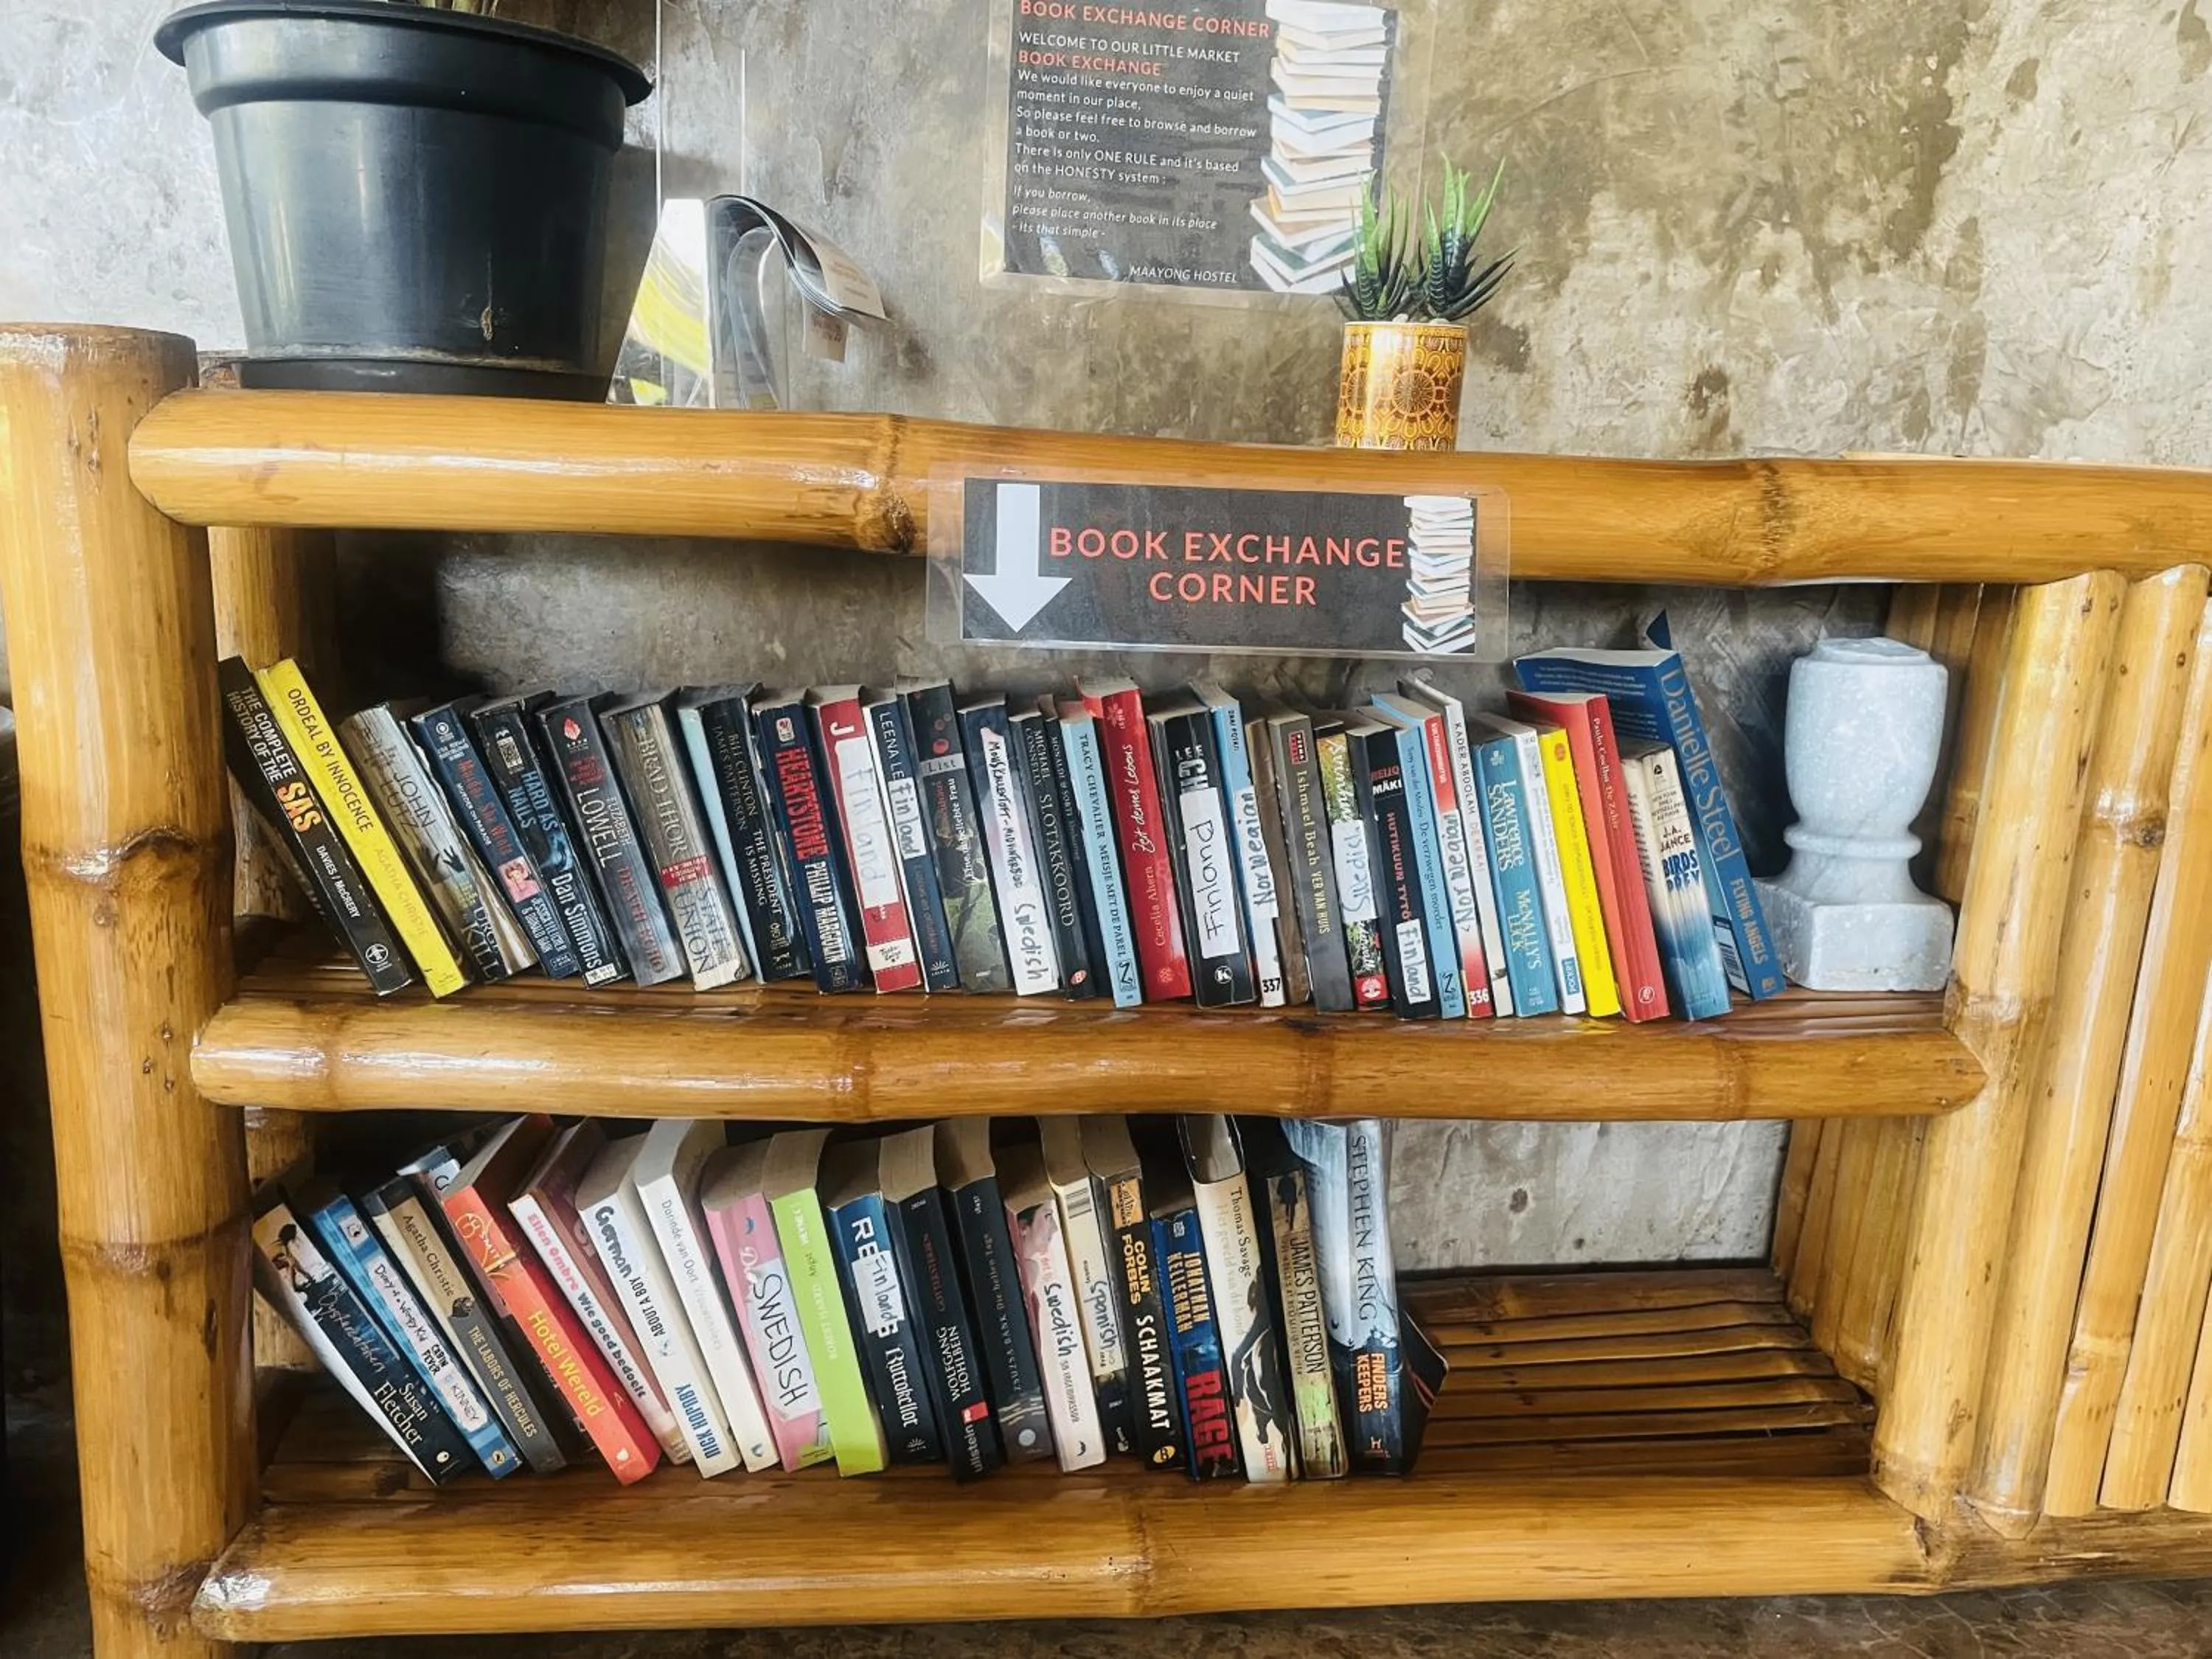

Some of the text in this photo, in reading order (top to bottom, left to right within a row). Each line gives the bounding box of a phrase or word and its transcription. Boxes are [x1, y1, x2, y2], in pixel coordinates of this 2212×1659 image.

[1019, 32, 1239, 63] WELCOME TO OUR LITTLE MARKET
[1021, 0, 1270, 38] BOOK EXCHANGE CORNER
[1018, 51, 1162, 76] BOOK EXCHANGE
[1018, 70, 1253, 103] We would like everyone to enjoy a quiet
[1017, 107, 1256, 138] So please feel free to browse and borrow
[1018, 90, 1141, 111] moment in our place,
[1015, 143, 1048, 157] There
[1053, 147, 1062, 158] is
[1065, 147, 1091, 164] only
[1094, 149, 1121, 162] ONE
[1125, 152, 1156, 166] RULE
[1160, 155, 1180, 168] and
[1206, 159, 1239, 173] based
[1016, 126, 1099, 143] a book or two.
[1013, 186, 1090, 203] If you borrow,
[1015, 164, 1161, 184] on the HONESTY system
[1012, 204, 1217, 230] please place another book in its place
[1037, 223, 1057, 236] that
[1062, 226, 1098, 240] simple
[1130, 265, 1237, 284] MAAYONG HOSTEL
[1050, 527, 1405, 568] BOOK EXCHANGE
[1149, 572, 1316, 605] CORNER
[228, 692, 283, 784] HISTORY THE
[254, 712, 295, 777] COMPLETE
[288, 688, 373, 832] ORDEAL BY INNOCENCE
[879, 712, 900, 759] LEENA
[1034, 731, 1050, 778] MICHAEL
[1175, 745, 1203, 762] LEE
[1455, 723, 1466, 757] KADER
[735, 760, 757, 815] CLINTON
[1079, 734, 1105, 838] TRACY CHEVALIER
[1372, 779, 1402, 795] MÄKI
[1660, 670, 1713, 786] Danielle
[1695, 787, 1739, 861] Steel
[275, 779, 323, 835] SAS
[380, 777, 417, 834] LUTZ
[393, 771, 435, 828] JOHN
[507, 786, 535, 828] NAILS
[521, 770, 557, 831] HARD AS
[639, 738, 669, 793] BRAD
[655, 797, 689, 857] THOR
[776, 746, 829, 858] HEARTSTONE
[888, 783, 925, 854] Finland
[1297, 771, 1314, 825] Ishmael
[1502, 780, 1525, 863] Lawrence
[577, 787, 623, 866] LOWELL
[753, 830, 766, 852] THE
[1305, 831, 1320, 865] Beah
[1488, 785, 1512, 870] SANDERS
[316, 844, 337, 875] DAVIES
[748, 858, 766, 905] MISSING
[759, 855, 782, 914] PRESIDENT
[804, 860, 832, 905] PHILLIP
[1040, 796, 1074, 925] SLOTAKKOORD
[1144, 867, 1158, 900] Ahern
[1189, 821, 1223, 939] Finland
[1662, 849, 1697, 877] BIRDS
[552, 872, 605, 969] Dan Simmons
[672, 890, 713, 973] UNION
[1730, 880, 1769, 963] FLYING ANGELS
[1262, 978, 1281, 992] 337
[1400, 928, 1426, 998] Finland
[1470, 988, 1489, 1004] 336
[402, 1215, 453, 1295] Agatha Christie
[530, 1214, 552, 1246] Ellen
[595, 1206, 633, 1279] German
[1231, 1187, 1253, 1276] Thomas Savage
[1350, 1135, 1375, 1320] STEPHEN KING
[1121, 1237, 1140, 1303] FORBES
[1133, 1242, 1150, 1291] COLIN
[1183, 1254, 1210, 1321] JONATHAN
[1290, 1239, 1314, 1287] JAMES
[629, 1276, 664, 1337] ABOUT BOY
[1044, 1284, 1076, 1356] Swedish
[1086, 1281, 1116, 1349] Spanish
[1168, 1253, 1192, 1331] KELLERMAN
[577, 1292, 646, 1397] Wie goed bedoelt
[748, 1273, 810, 1405] SWEDISH
[948, 1326, 970, 1392] HOHLBEIN
[1295, 1291, 1325, 1373] PATTERSON
[478, 1343, 535, 1437] LABORS HERCULES
[529, 1310, 602, 1416] Hotel Wereld
[884, 1346, 919, 1426] Ruttokellot
[936, 1327, 960, 1401] WOLFGANG
[1135, 1315, 1170, 1428] SCHAAKMAT
[1356, 1355, 1371, 1411] KEEPERS
[1371, 1352, 1387, 1409] FINDERS
[375, 1380, 422, 1446] Fletcher
[399, 1383, 428, 1420] Susan
[675, 1383, 720, 1458] NICK HORNBY
[1183, 1372, 1233, 1462] RAGE
[964, 1425, 981, 1470] ullstein
